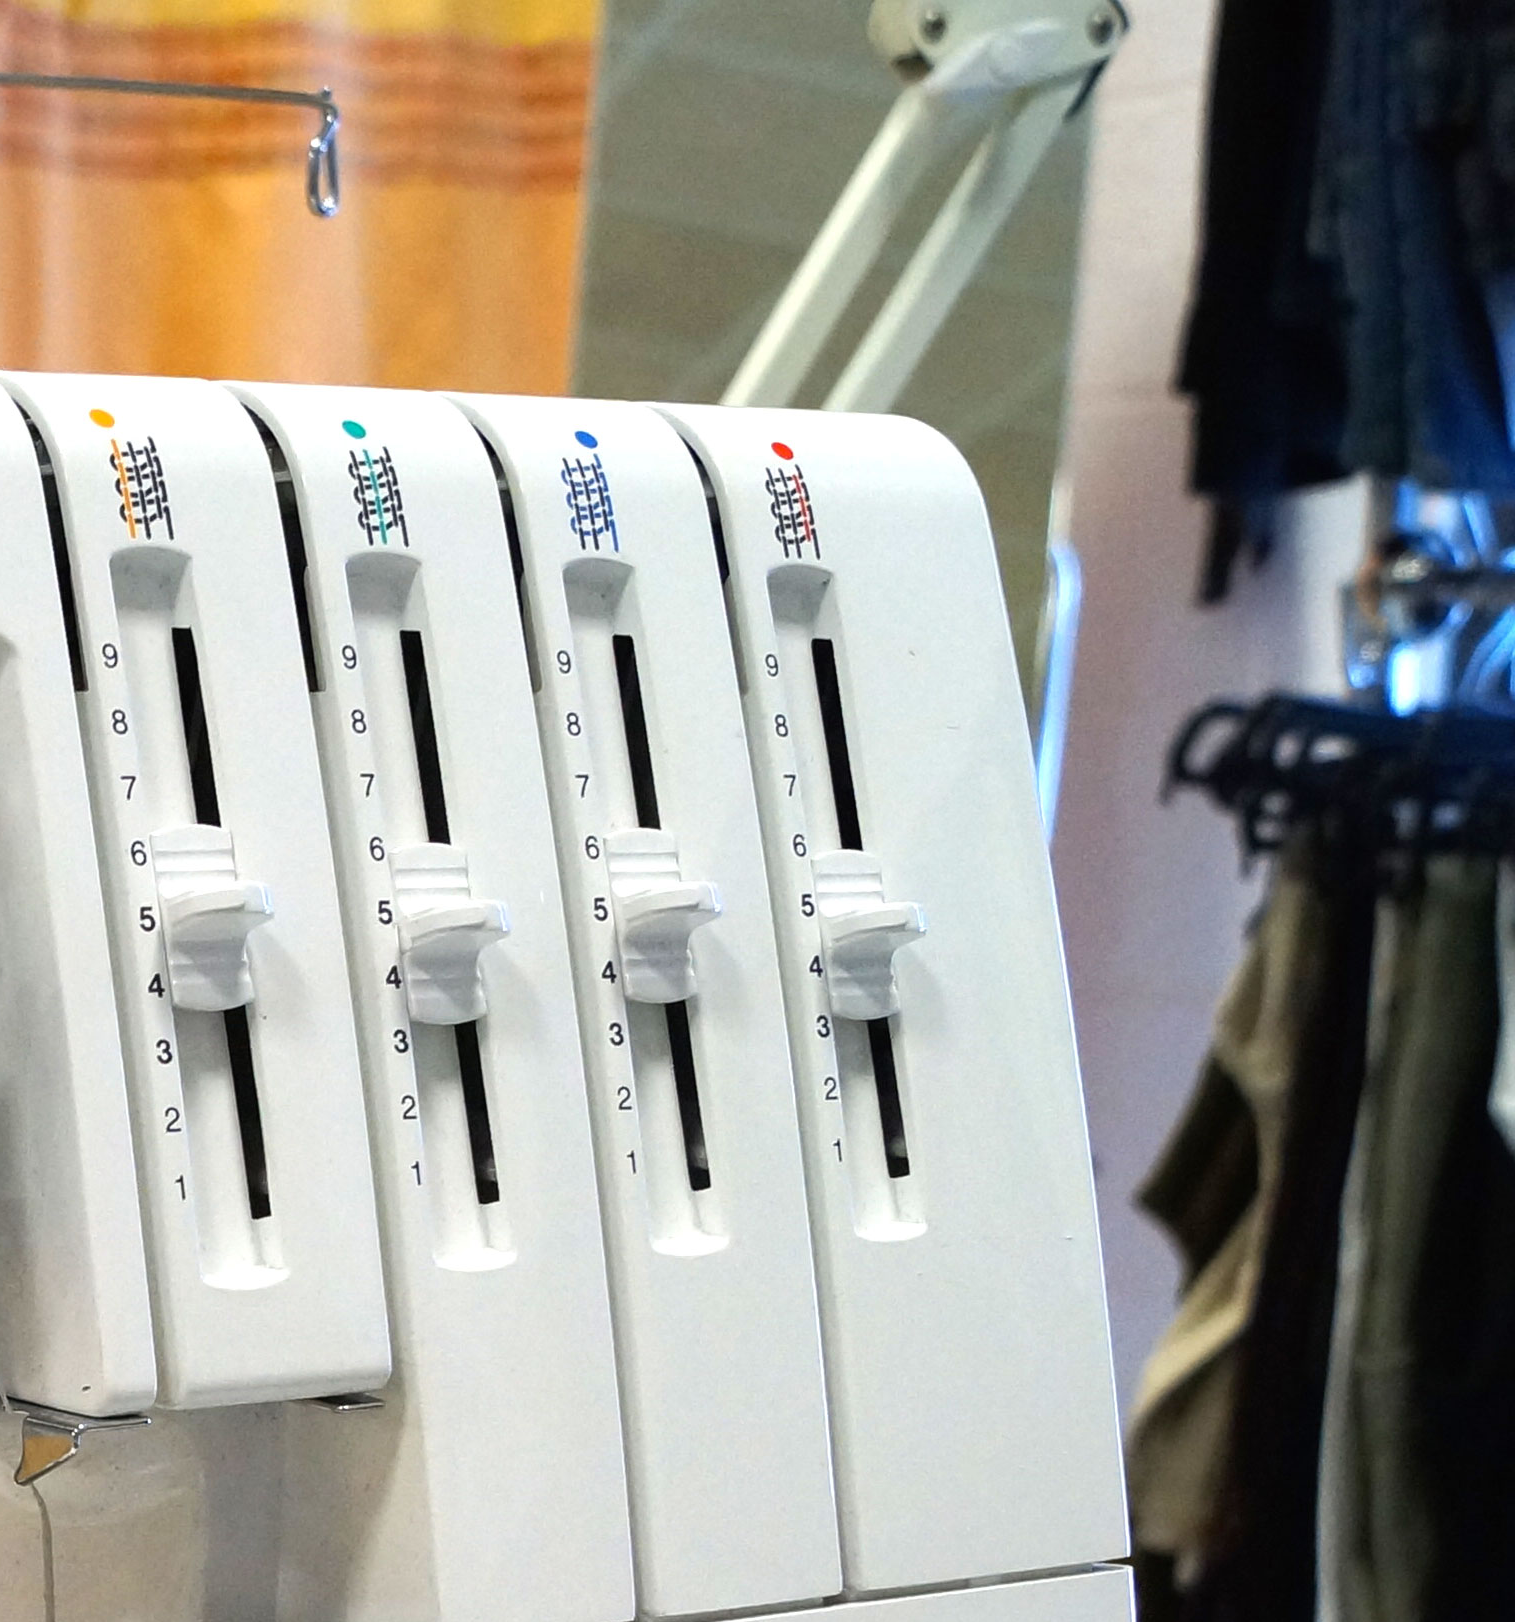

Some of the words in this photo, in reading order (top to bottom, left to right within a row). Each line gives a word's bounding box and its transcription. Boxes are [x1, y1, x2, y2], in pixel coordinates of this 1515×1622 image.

[101, 642, 119, 669] 9
[341, 644, 358, 670] 9
[556, 649, 572, 675] 9
[764, 653, 779, 678] 9
[111, 708, 129, 736] 8
[350, 708, 368, 735] 8
[566, 711, 582, 737] 8
[774, 713, 789, 738] 8
[119, 775, 137, 801] 7
[359, 772, 375, 798] 7
[574, 773, 590, 799] 7
[782, 773, 797, 797] 7
[130, 839, 148, 867] 6
[369, 836, 386, 862] 6
[584, 835, 600, 861] 6
[792, 833, 807, 858] 6
[377, 899, 394, 926] 5
[593, 896, 609, 922] 5
[801, 893, 816, 918] 5
[139, 905, 157, 933] 5
[386, 966, 402, 989] 4
[601, 960, 618, 985] 4
[809, 955, 823, 978] 4
[147, 972, 167, 999] 4
[608, 1021, 625, 1047] 3
[816, 1014, 831, 1039] 3
[155, 1038, 174, 1065] 3
[392, 1028, 410, 1054] 3
[617, 1085, 633, 1111] 2
[824, 1077, 838, 1101] 2
[164, 1106, 182, 1134] 2
[400, 1094, 418, 1121] 2
[626, 1149, 637, 1175] 1
[832, 1138, 843, 1163] 1
[410, 1160, 422, 1186] 1
[174, 1174, 187, 1201] 1
